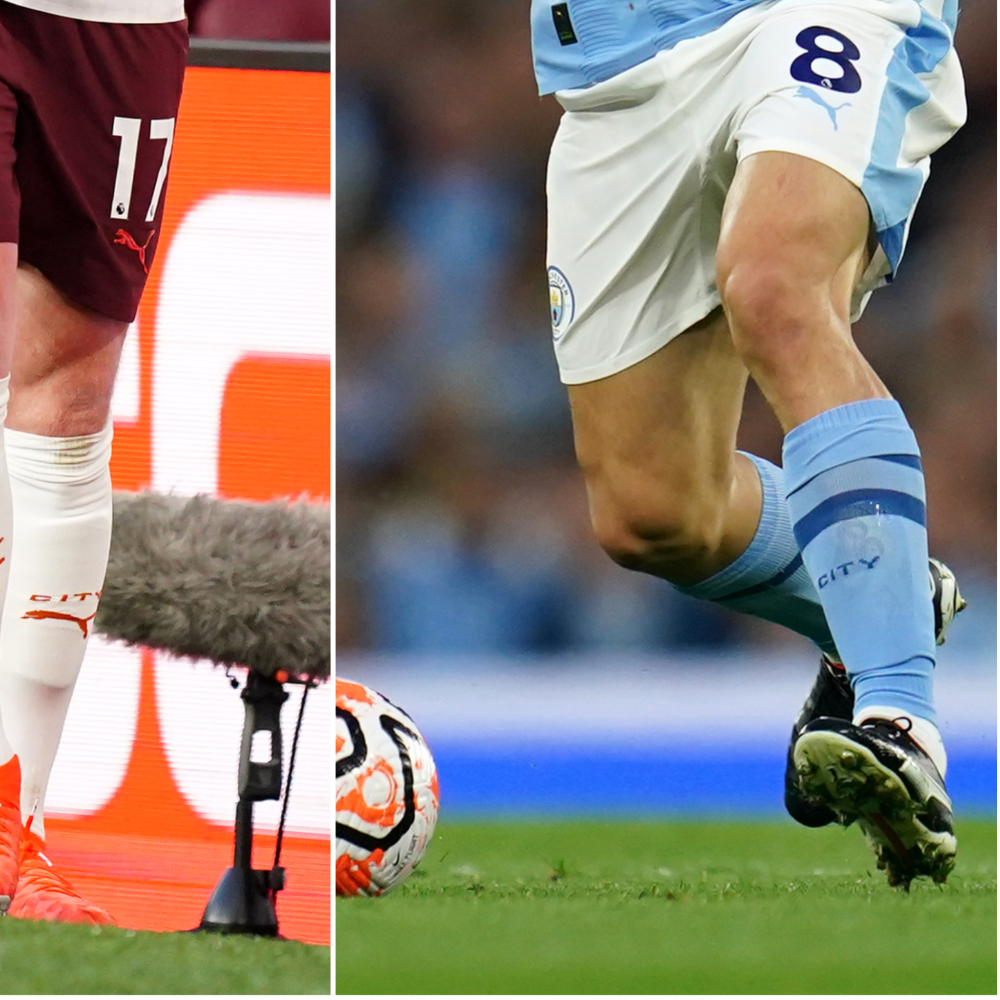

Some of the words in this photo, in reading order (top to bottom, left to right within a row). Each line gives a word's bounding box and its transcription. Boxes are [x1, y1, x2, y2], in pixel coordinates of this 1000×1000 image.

[790, 25, 862, 94] 8
[110, 116, 175, 222] 17
[30, 590, 103, 601] CITY
[818, 555, 880, 590] CITY
